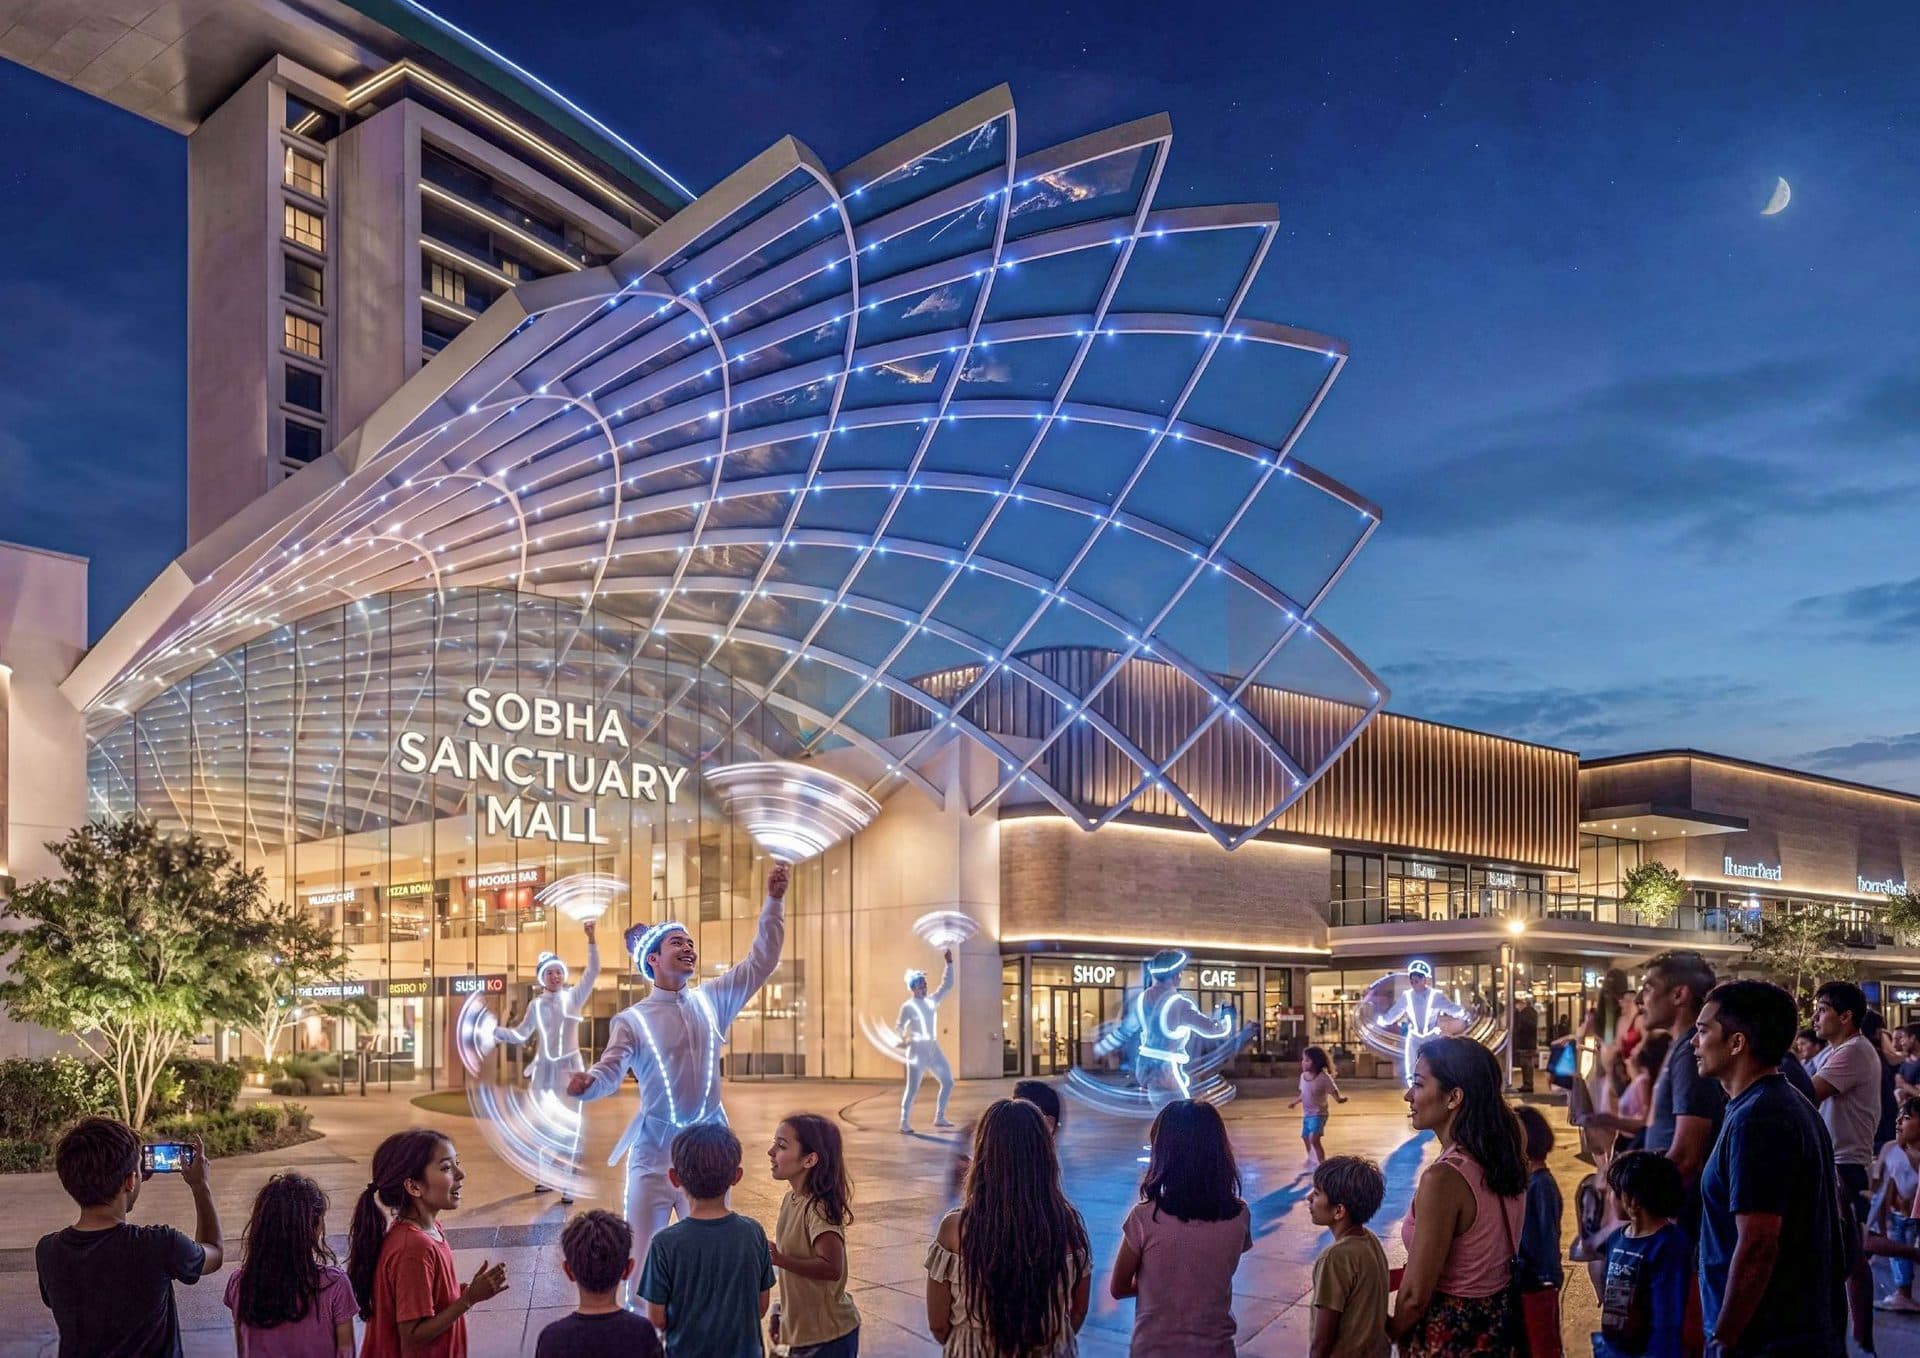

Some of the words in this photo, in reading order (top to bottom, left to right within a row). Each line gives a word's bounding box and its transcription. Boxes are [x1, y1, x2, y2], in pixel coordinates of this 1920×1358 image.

[466, 687, 629, 747] SOBHA
[400, 731, 688, 803] SANCTUARY
[487, 795, 608, 844] MALL
[478, 873, 517, 887] NOODLE
[519, 871, 538, 881] BAR
[1073, 965, 1116, 983] SHOP
[1201, 970, 1236, 987] CAFE
[313, 986, 342, 996] COFFEE
[343, 984, 365, 995] BEAN
[390, 983, 417, 993] BISTRO
[418, 982, 428, 993] 19
[455, 980, 485, 992] SUSHI
[487, 979, 503, 991] KO
